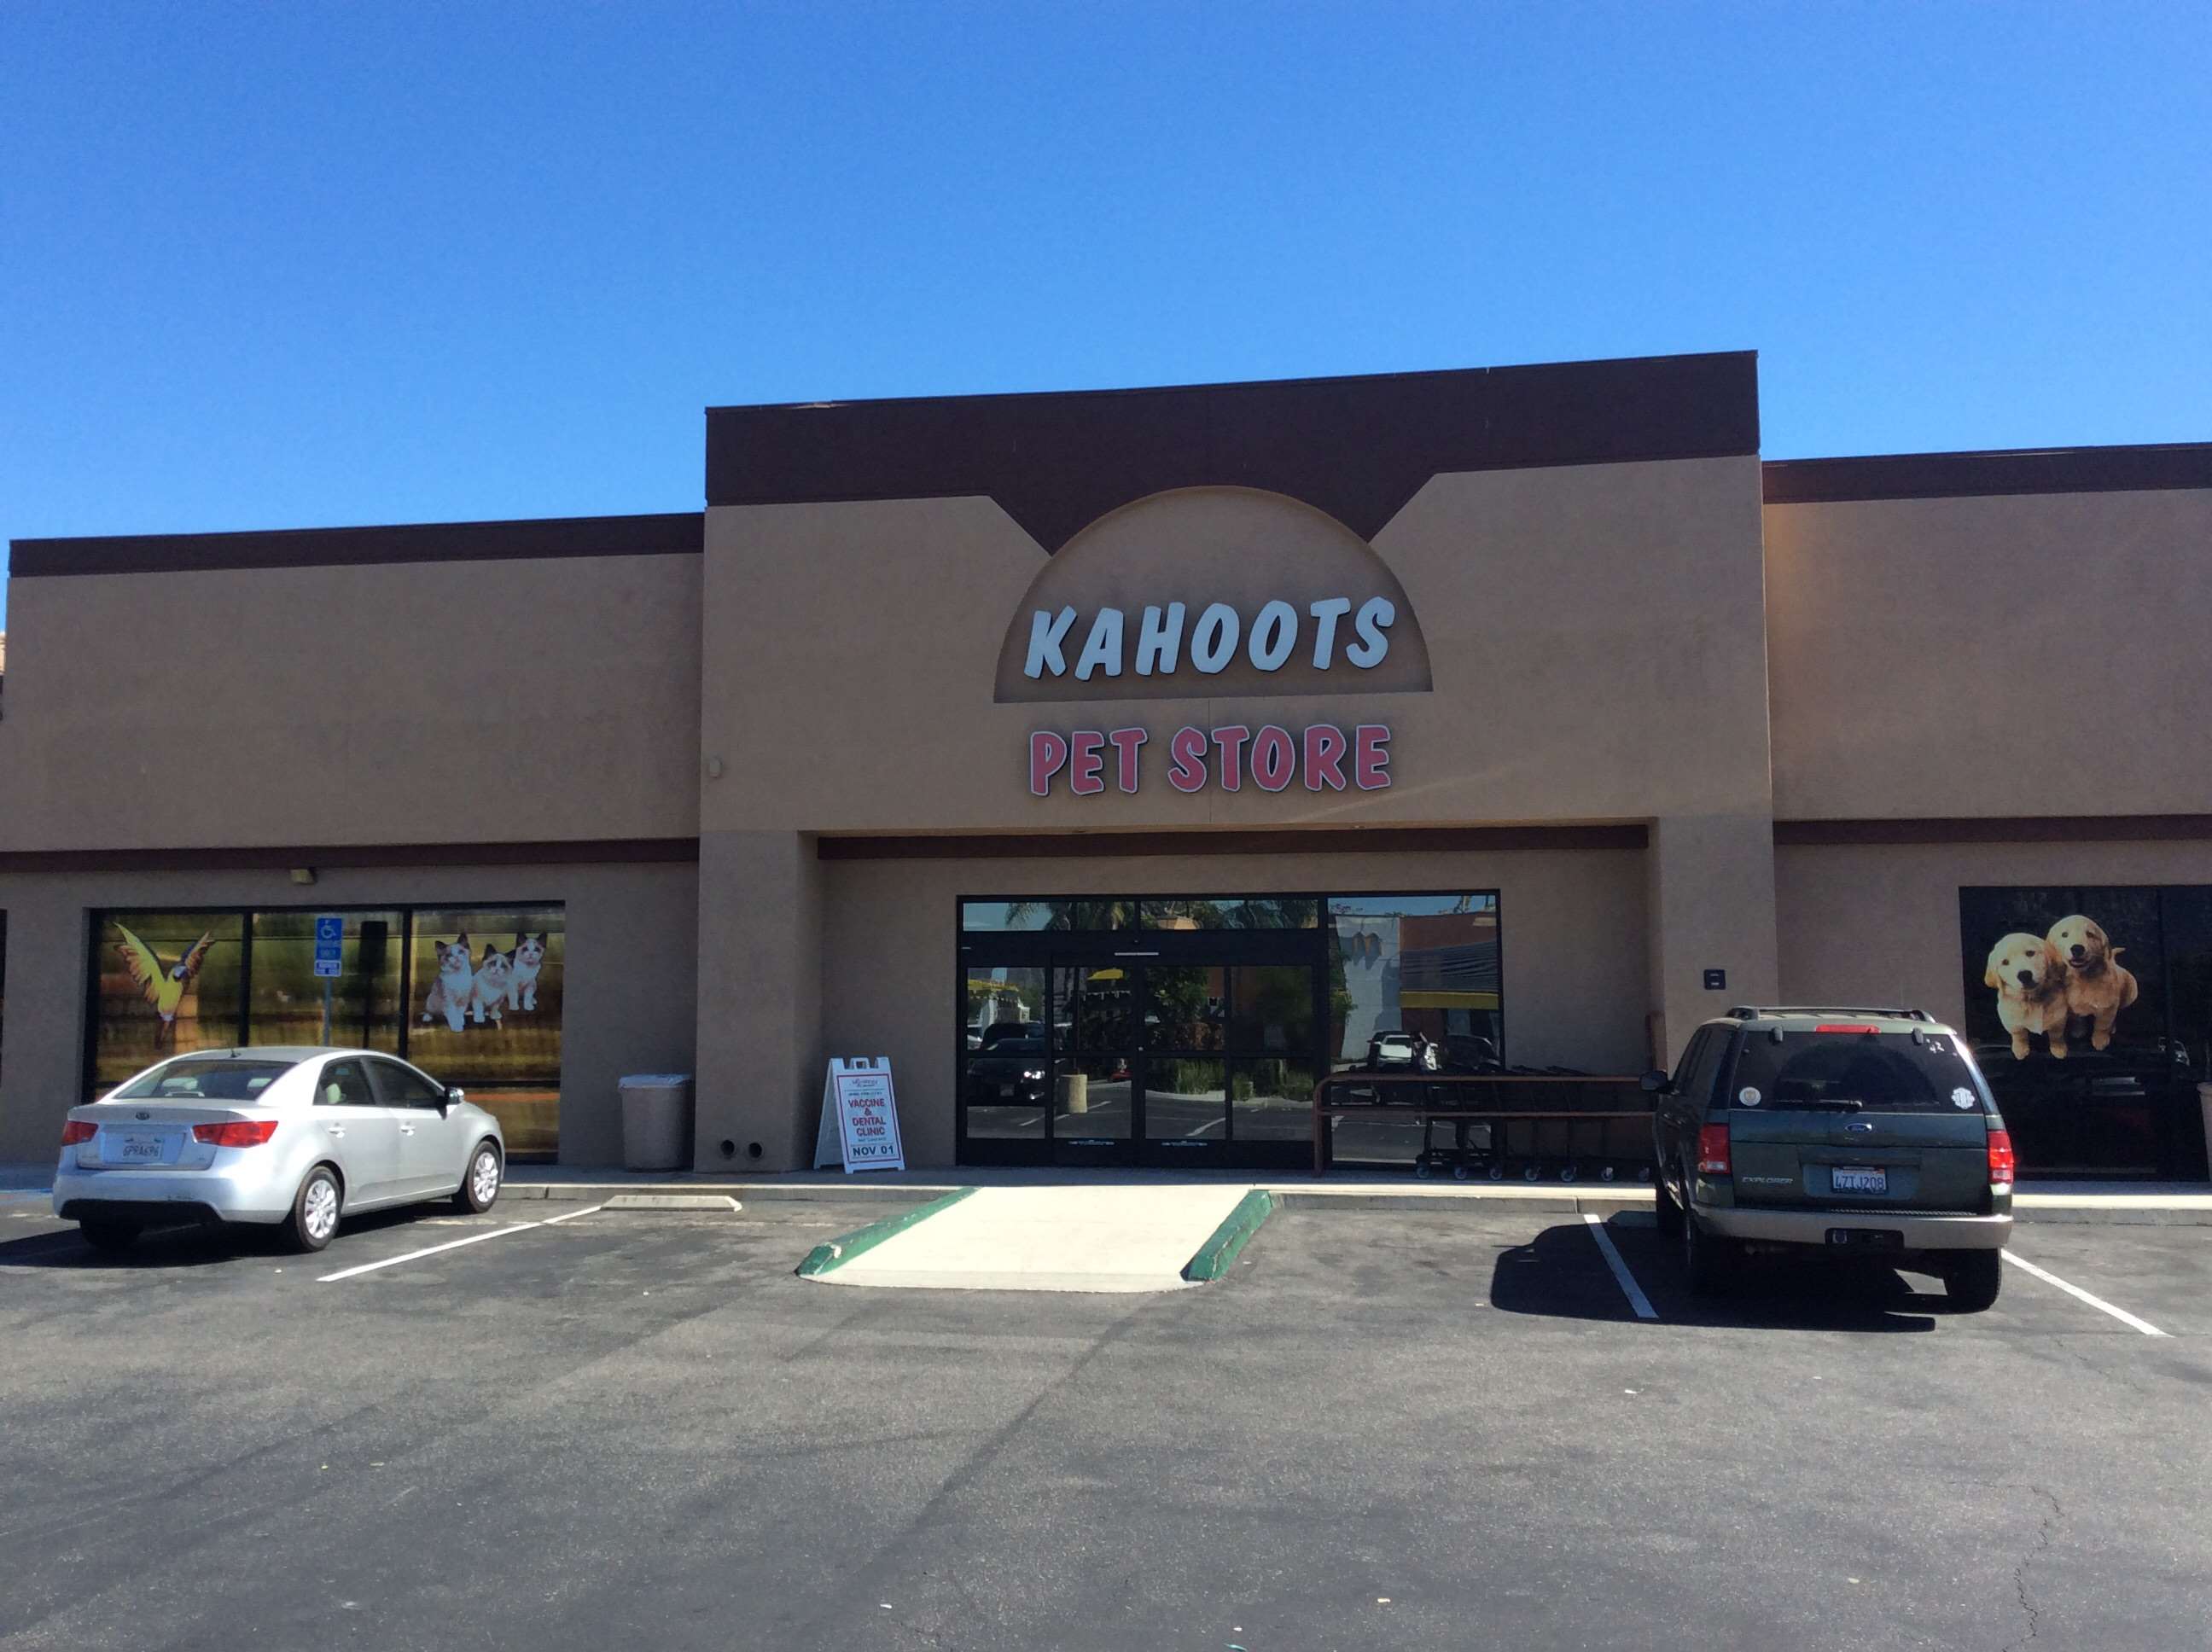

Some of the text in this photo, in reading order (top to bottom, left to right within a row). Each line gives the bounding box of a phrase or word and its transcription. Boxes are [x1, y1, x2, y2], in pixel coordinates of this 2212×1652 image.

[1024, 596, 1395, 681] KAHOOTS
[1030, 724, 1391, 795] PET STORE
[848, 1098, 885, 1108] VACCINE
[864, 1108, 872, 1116] &
[853, 1117, 887, 1126] DENTAL
[856, 1127, 885, 1137] CLINIC
[853, 1145, 894, 1155] NOV 01
